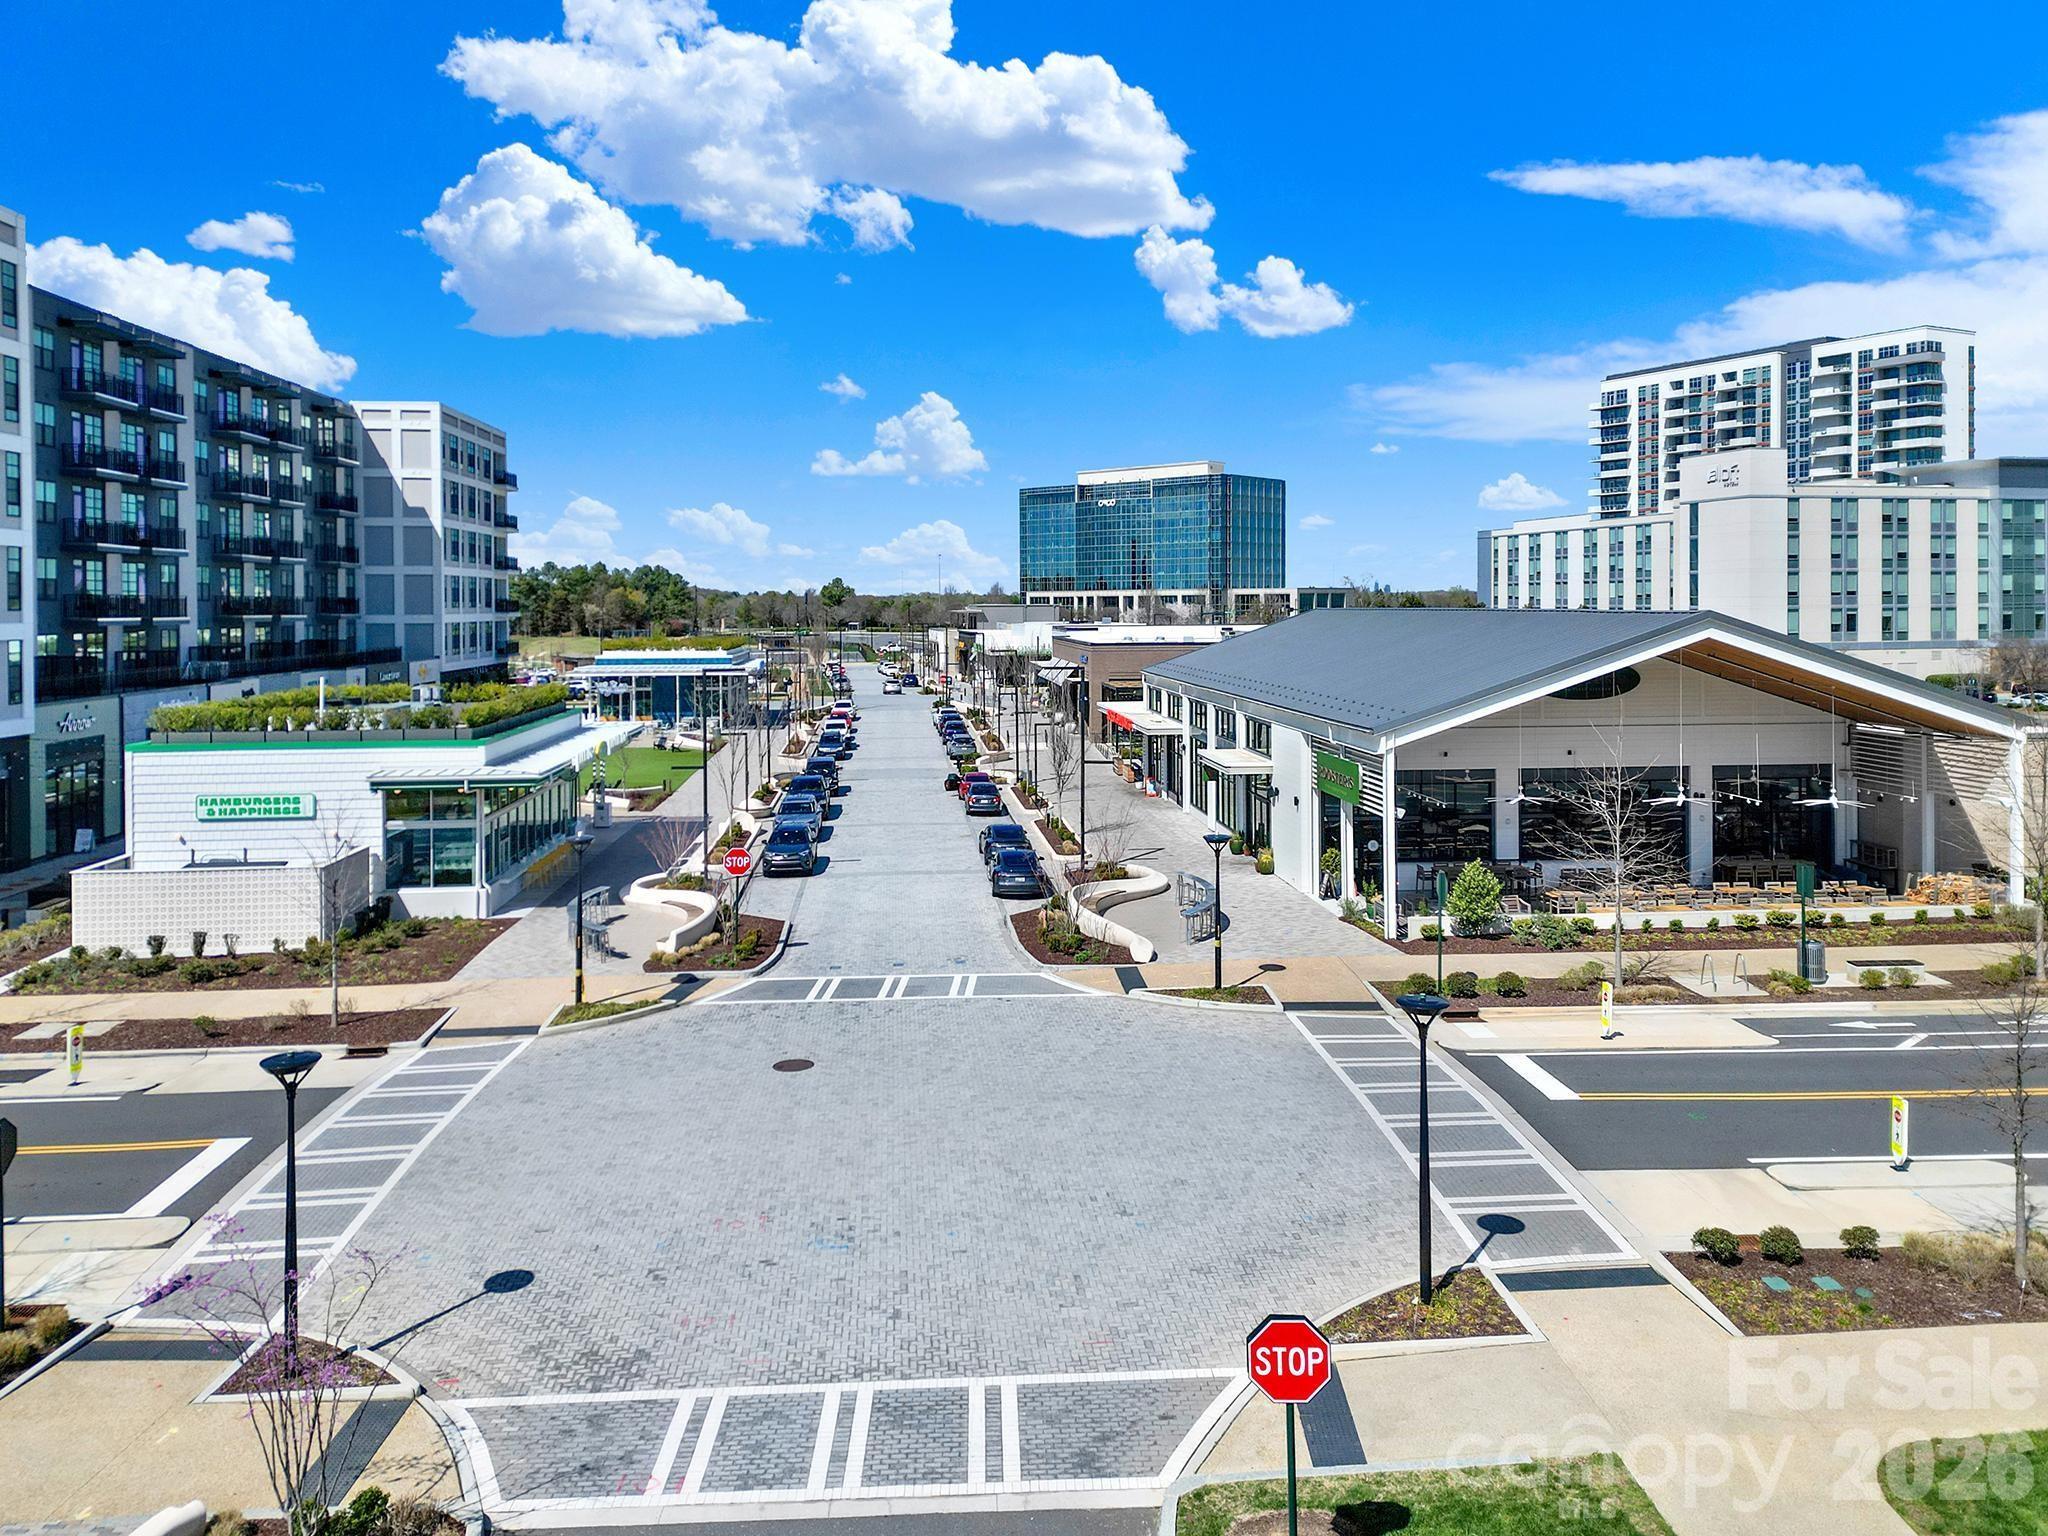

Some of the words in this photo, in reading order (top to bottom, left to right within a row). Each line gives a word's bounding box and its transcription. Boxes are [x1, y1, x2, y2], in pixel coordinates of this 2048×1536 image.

[199, 796, 301, 807] HAMBURGERS
[206, 808, 216, 817] &
[218, 806, 301, 816] HAPPINESS
[725, 856, 750, 868] STOP
[1254, 1346, 1325, 1377] STOP
